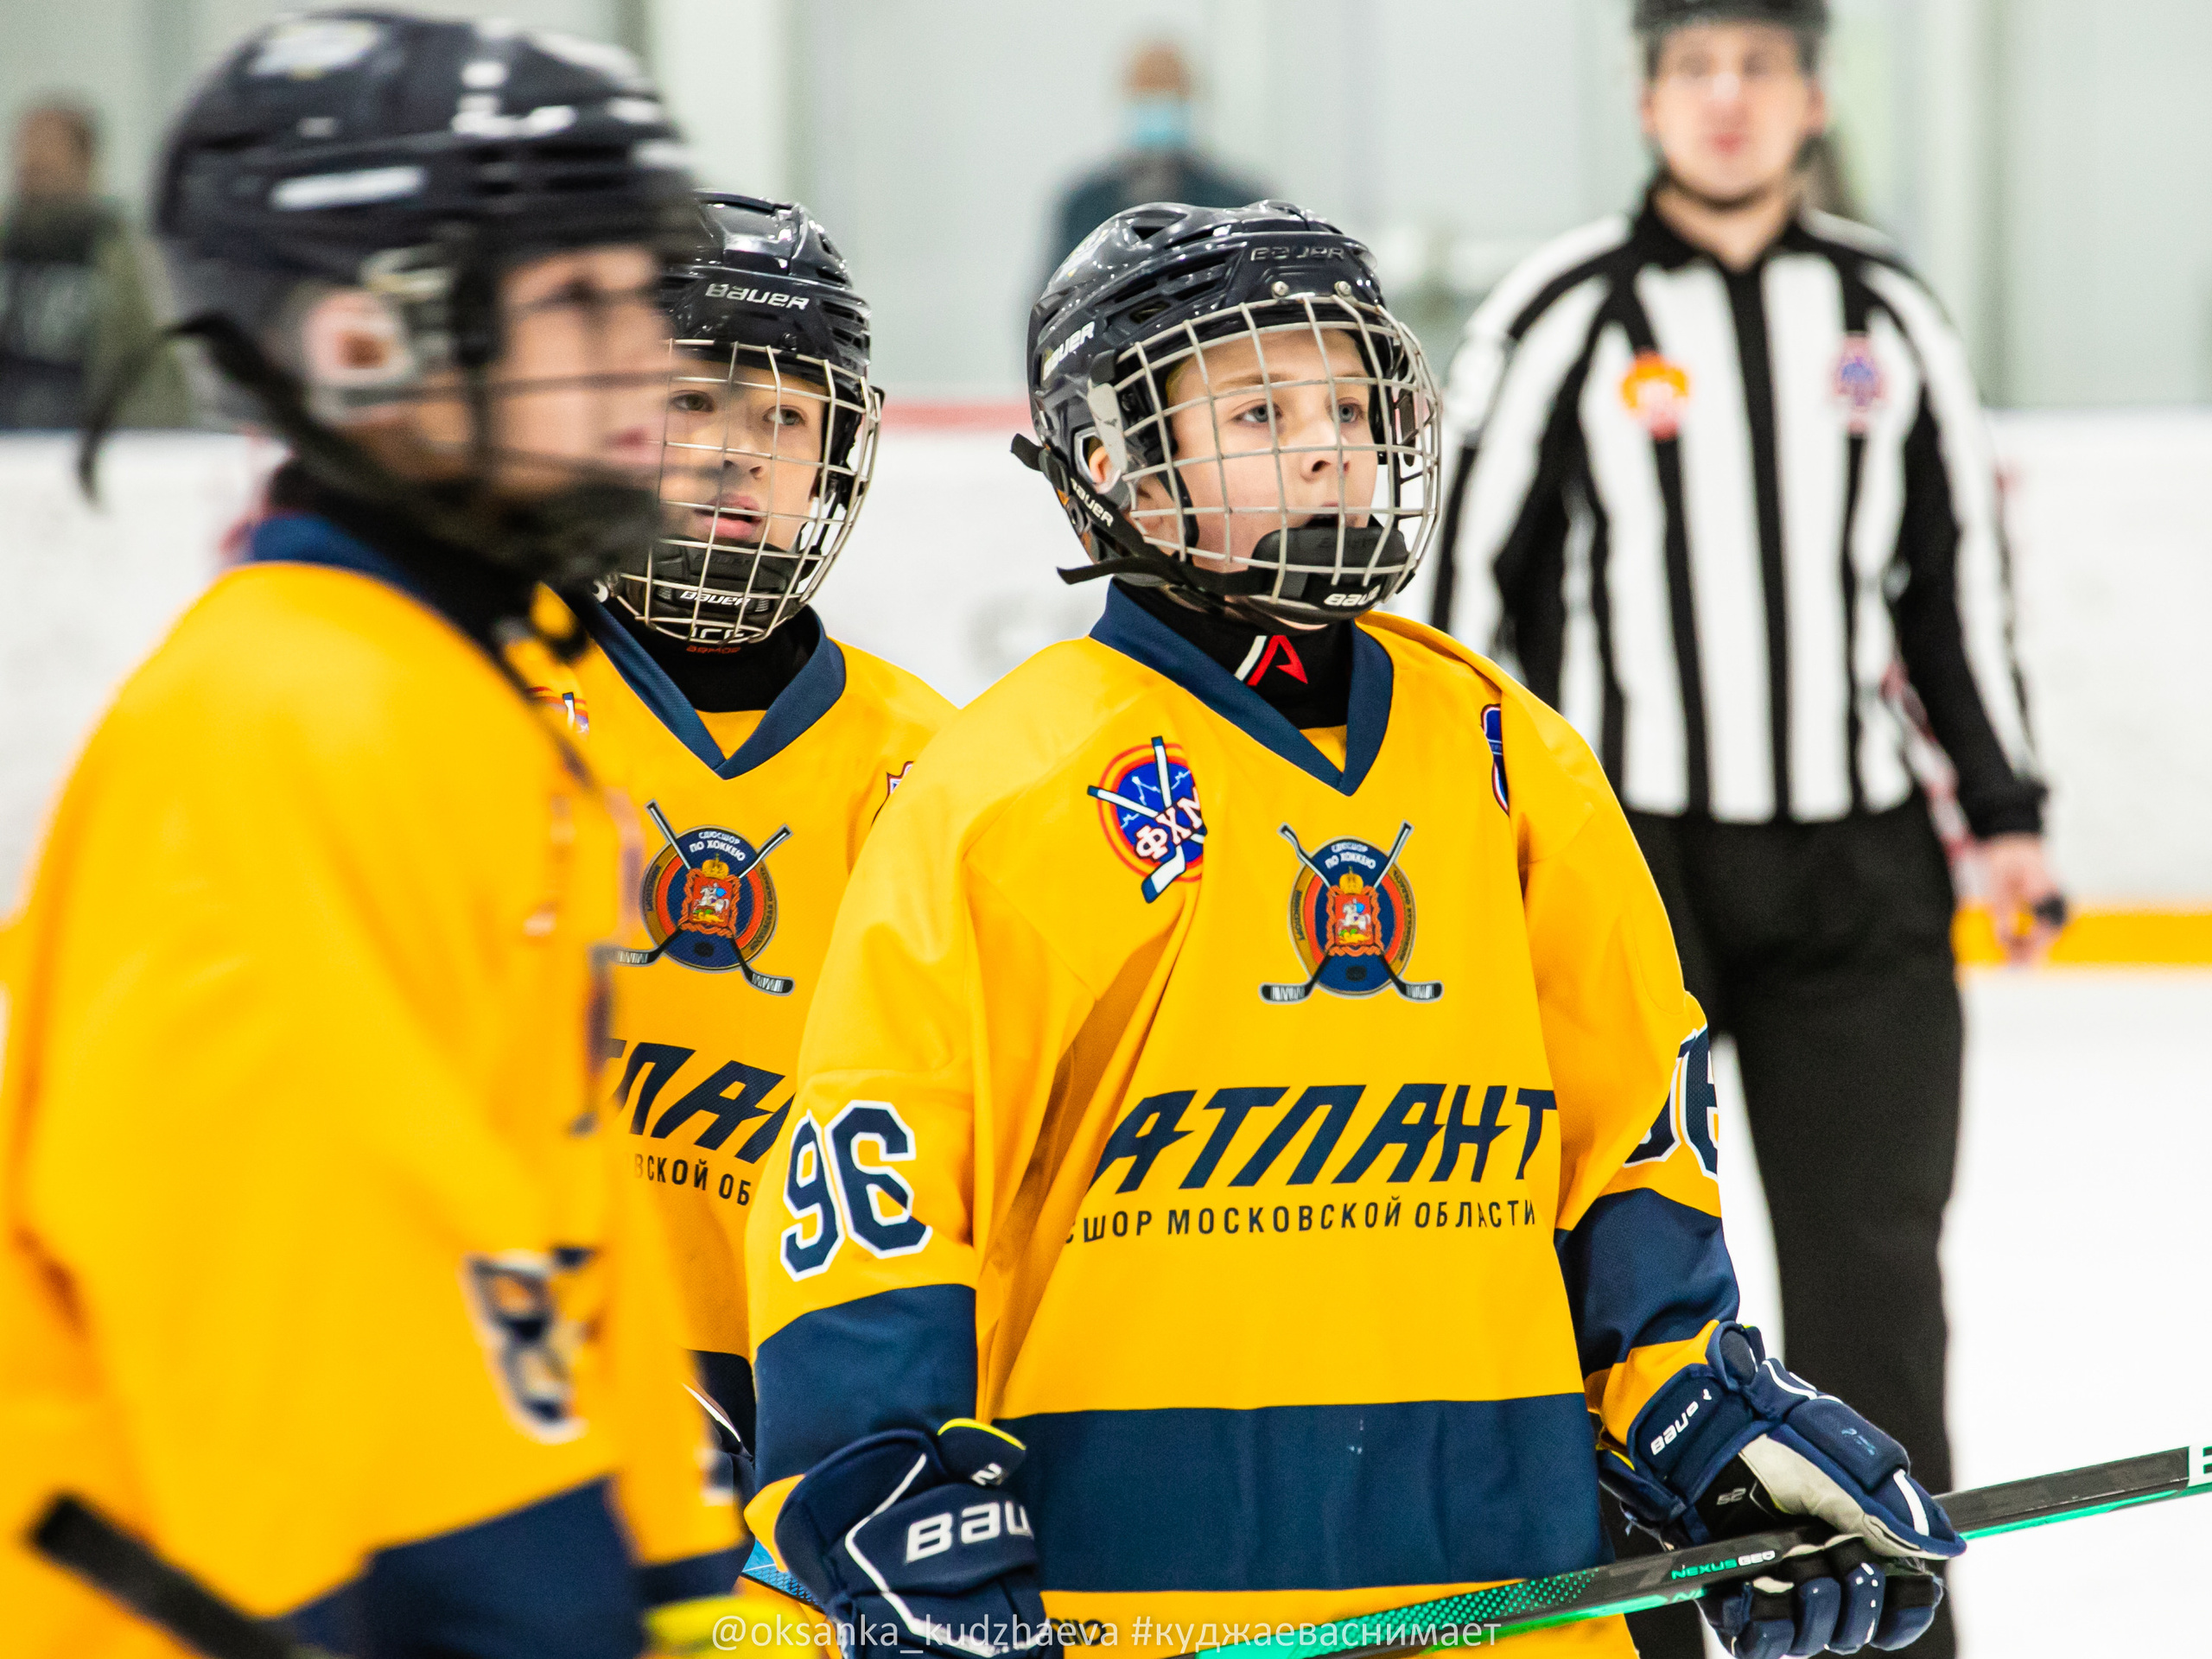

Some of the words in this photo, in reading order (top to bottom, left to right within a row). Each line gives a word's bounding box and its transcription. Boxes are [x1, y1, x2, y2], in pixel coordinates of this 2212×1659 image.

[780, 1100, 934, 1282] 96
[1087, 1083, 1558, 1194] АТЛАНТ
[1065, 1210, 1153, 1243] ШОР
[1166, 1194, 1400, 1236] МОСКОВСКОЙ
[1414, 1198, 1536, 1229] ОБЛАСТИ
